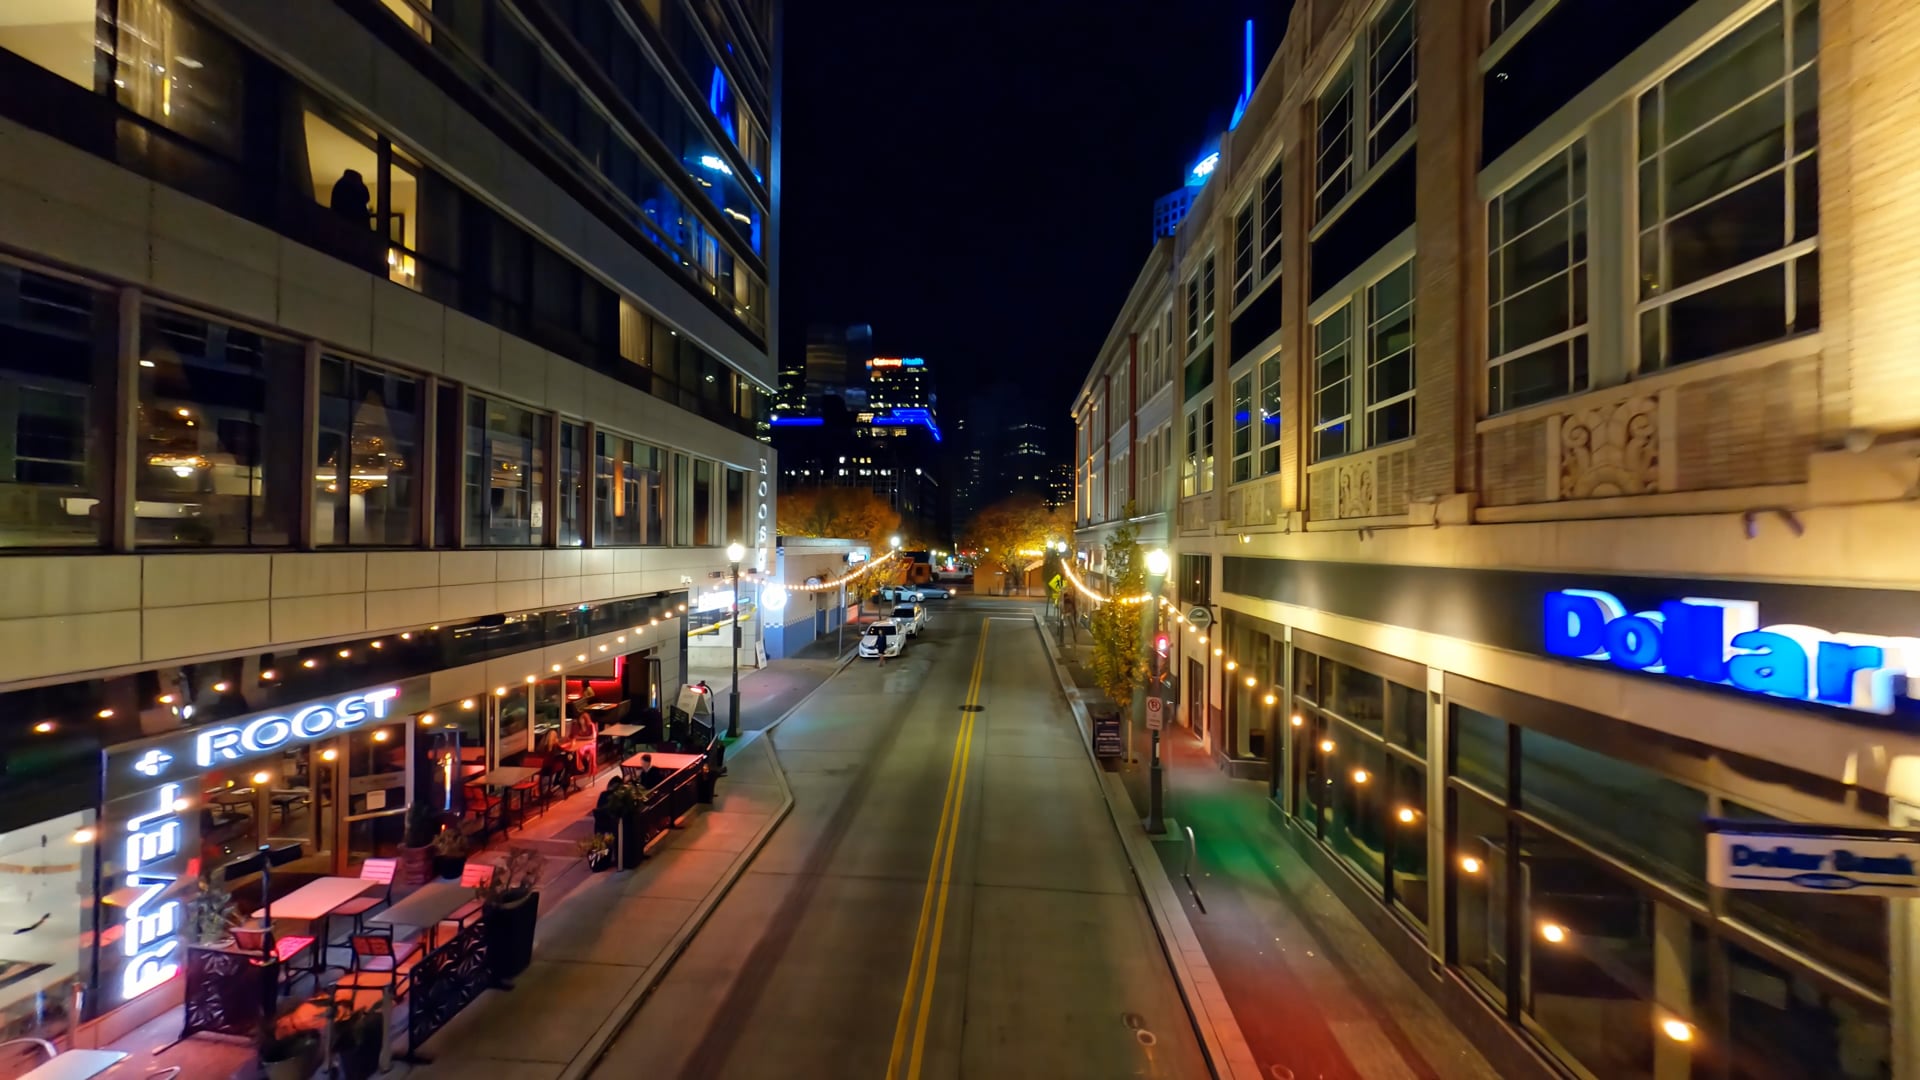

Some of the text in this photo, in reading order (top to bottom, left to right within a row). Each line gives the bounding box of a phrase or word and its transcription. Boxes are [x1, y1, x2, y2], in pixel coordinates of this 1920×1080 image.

[1544, 589, 1886, 710] Dollar
[196, 687, 400, 768] ROOST
[121, 782, 182, 1000] REVEL
[1730, 843, 1823, 872] Doll
